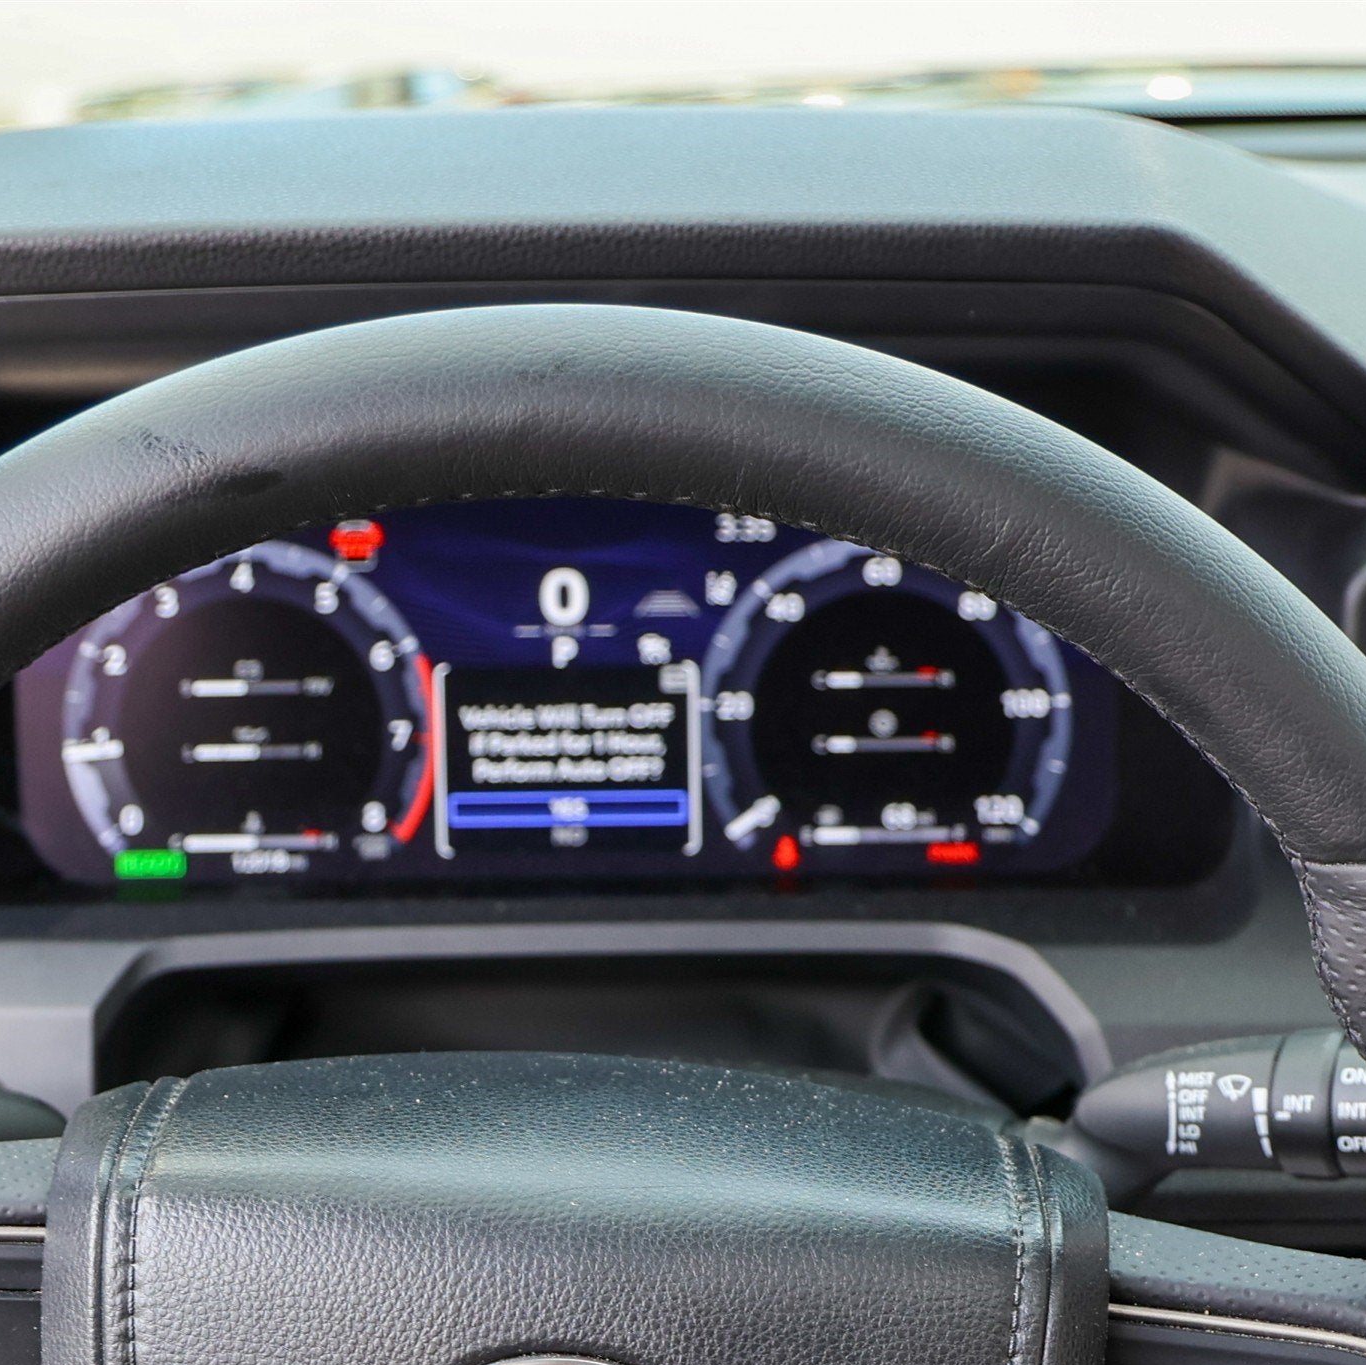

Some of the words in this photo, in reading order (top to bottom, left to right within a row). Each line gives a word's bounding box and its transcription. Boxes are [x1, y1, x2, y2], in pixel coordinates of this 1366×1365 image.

[540, 567, 590, 627] 0
[551, 635, 579, 669] P
[1177, 1070, 1218, 1088] MIST
[1177, 1089, 1209, 1106] OFF
[1282, 1094, 1315, 1114] INT
[1177, 1106, 1206, 1122] INT
[1177, 1123, 1202, 1141] LO
